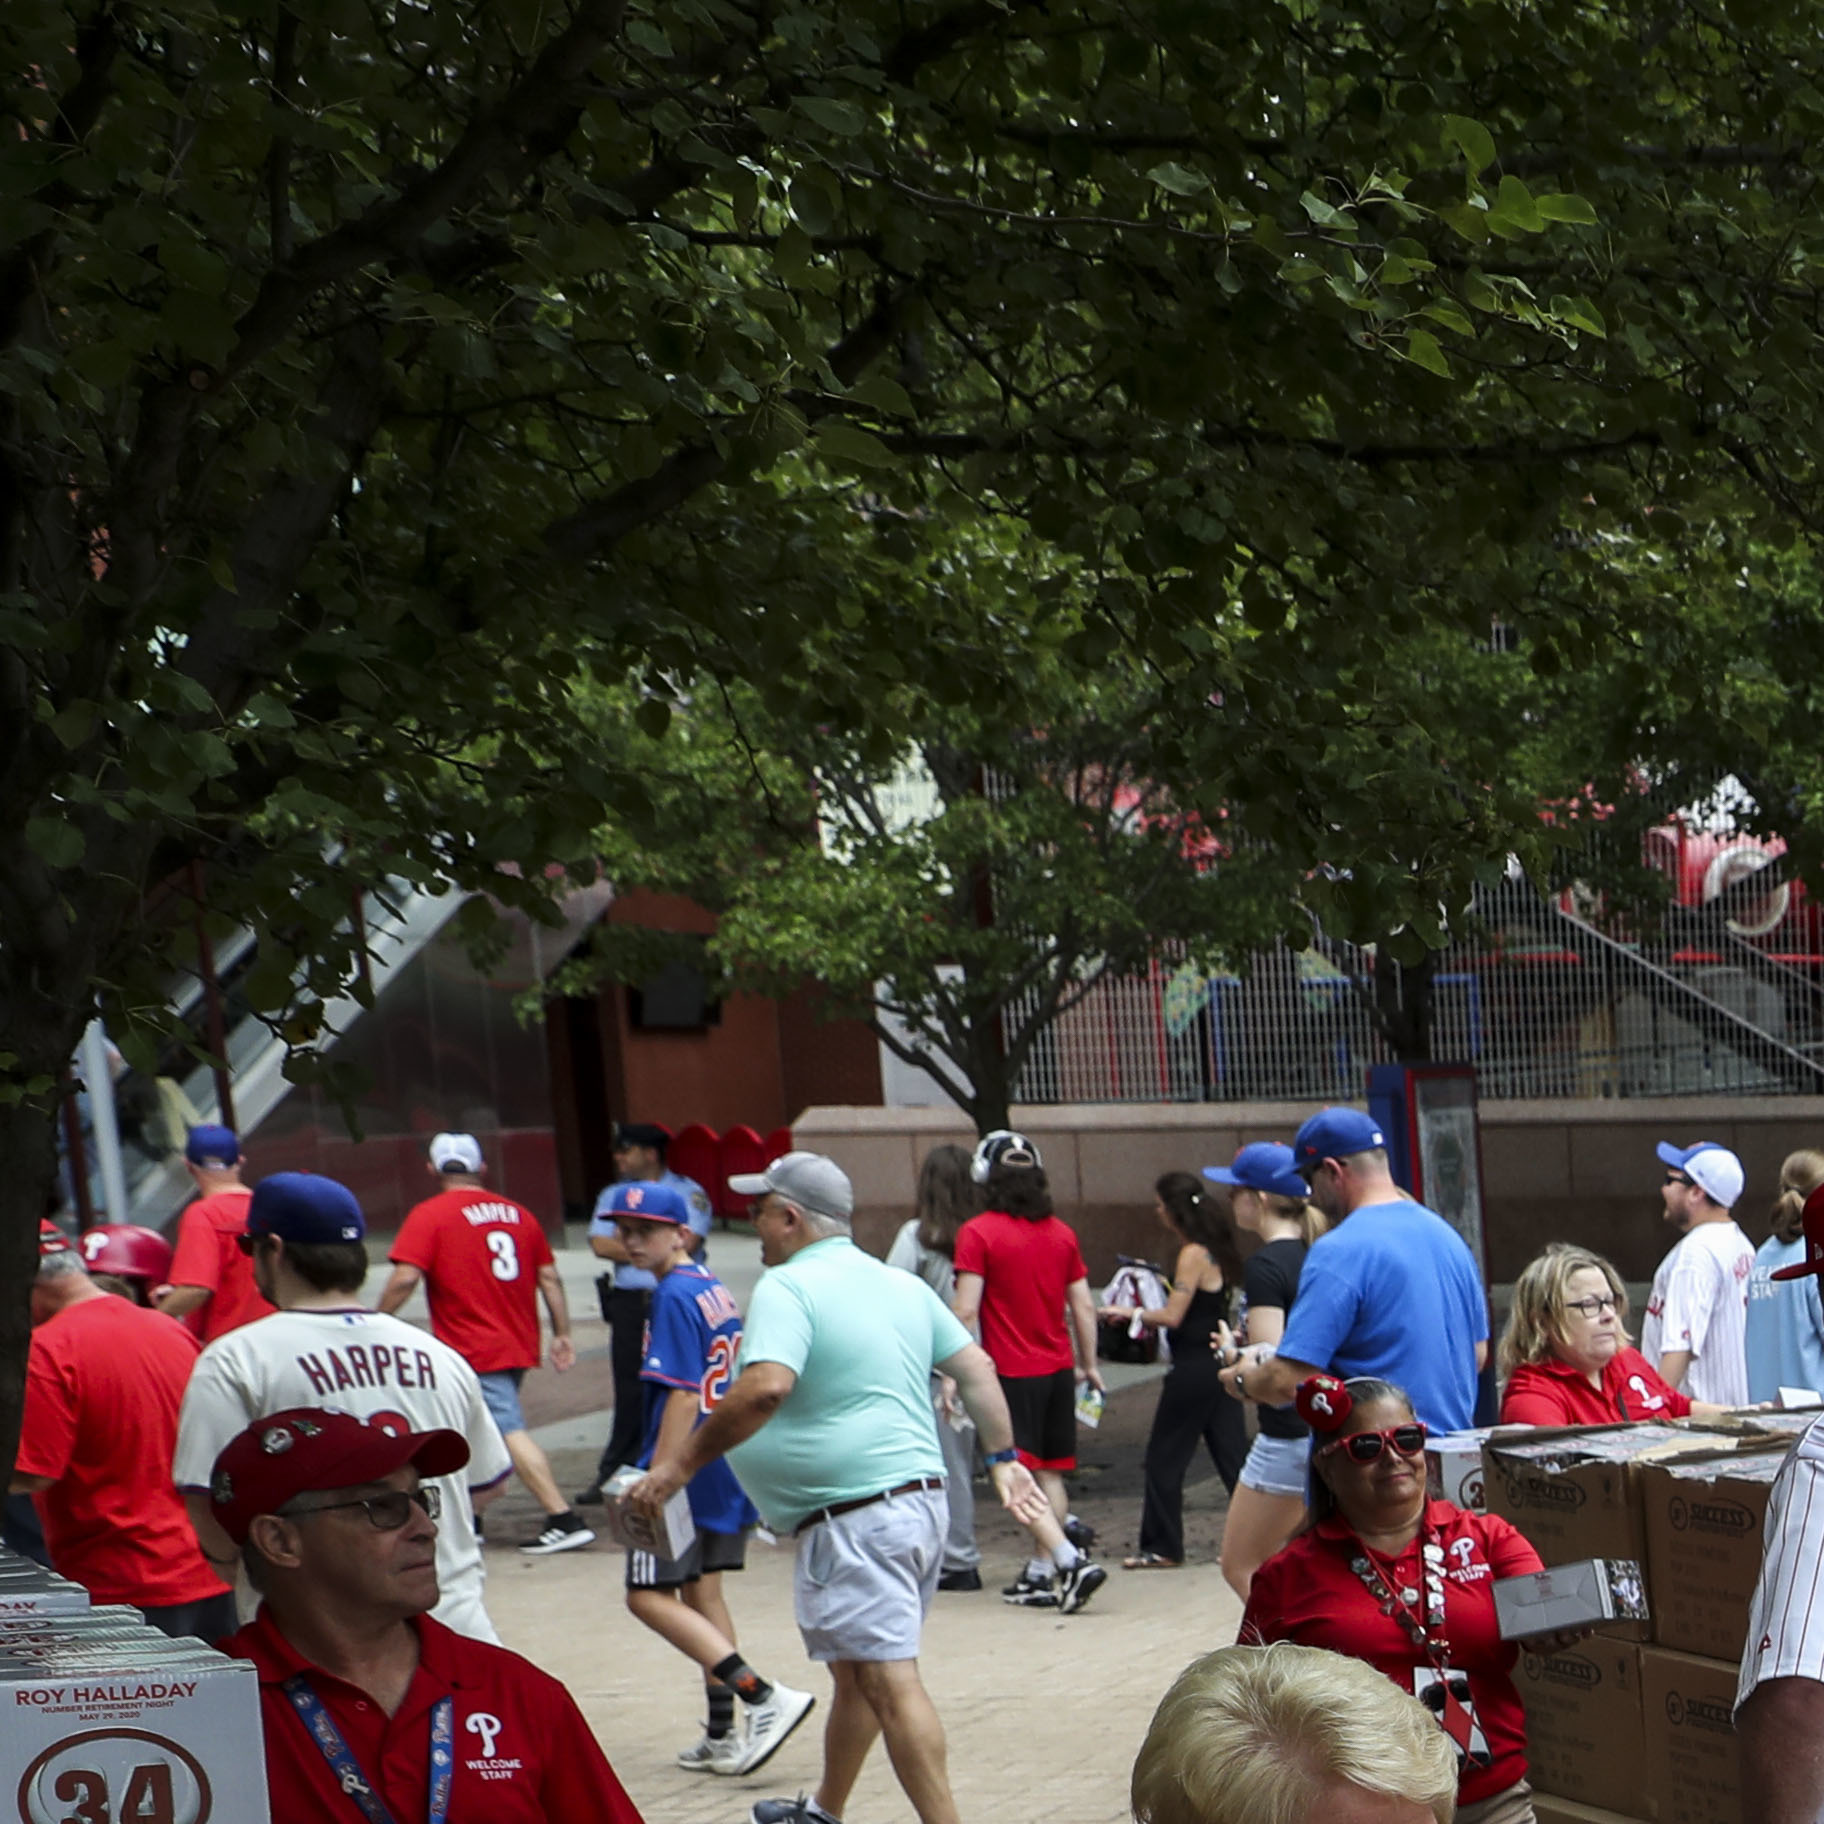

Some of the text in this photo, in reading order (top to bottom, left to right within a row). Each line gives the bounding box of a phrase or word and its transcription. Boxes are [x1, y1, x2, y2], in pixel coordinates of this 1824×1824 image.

[460, 1201, 521, 1227] HARPER
[485, 1231, 521, 1282] 3
[296, 1343, 437, 1397] HARPER
[1449, 1562, 1491, 1580] WELCOME
[15, 1681, 199, 1706] ROY HALLADAY
[41, 1700, 175, 1715] NUMBER RETIREMENT NIGHT
[79, 1710, 141, 1721] MAY 2020
[465, 1712, 502, 1758] P
[465, 1758, 523, 1771] WELCOME
[480, 1769, 514, 1781] STAFF
